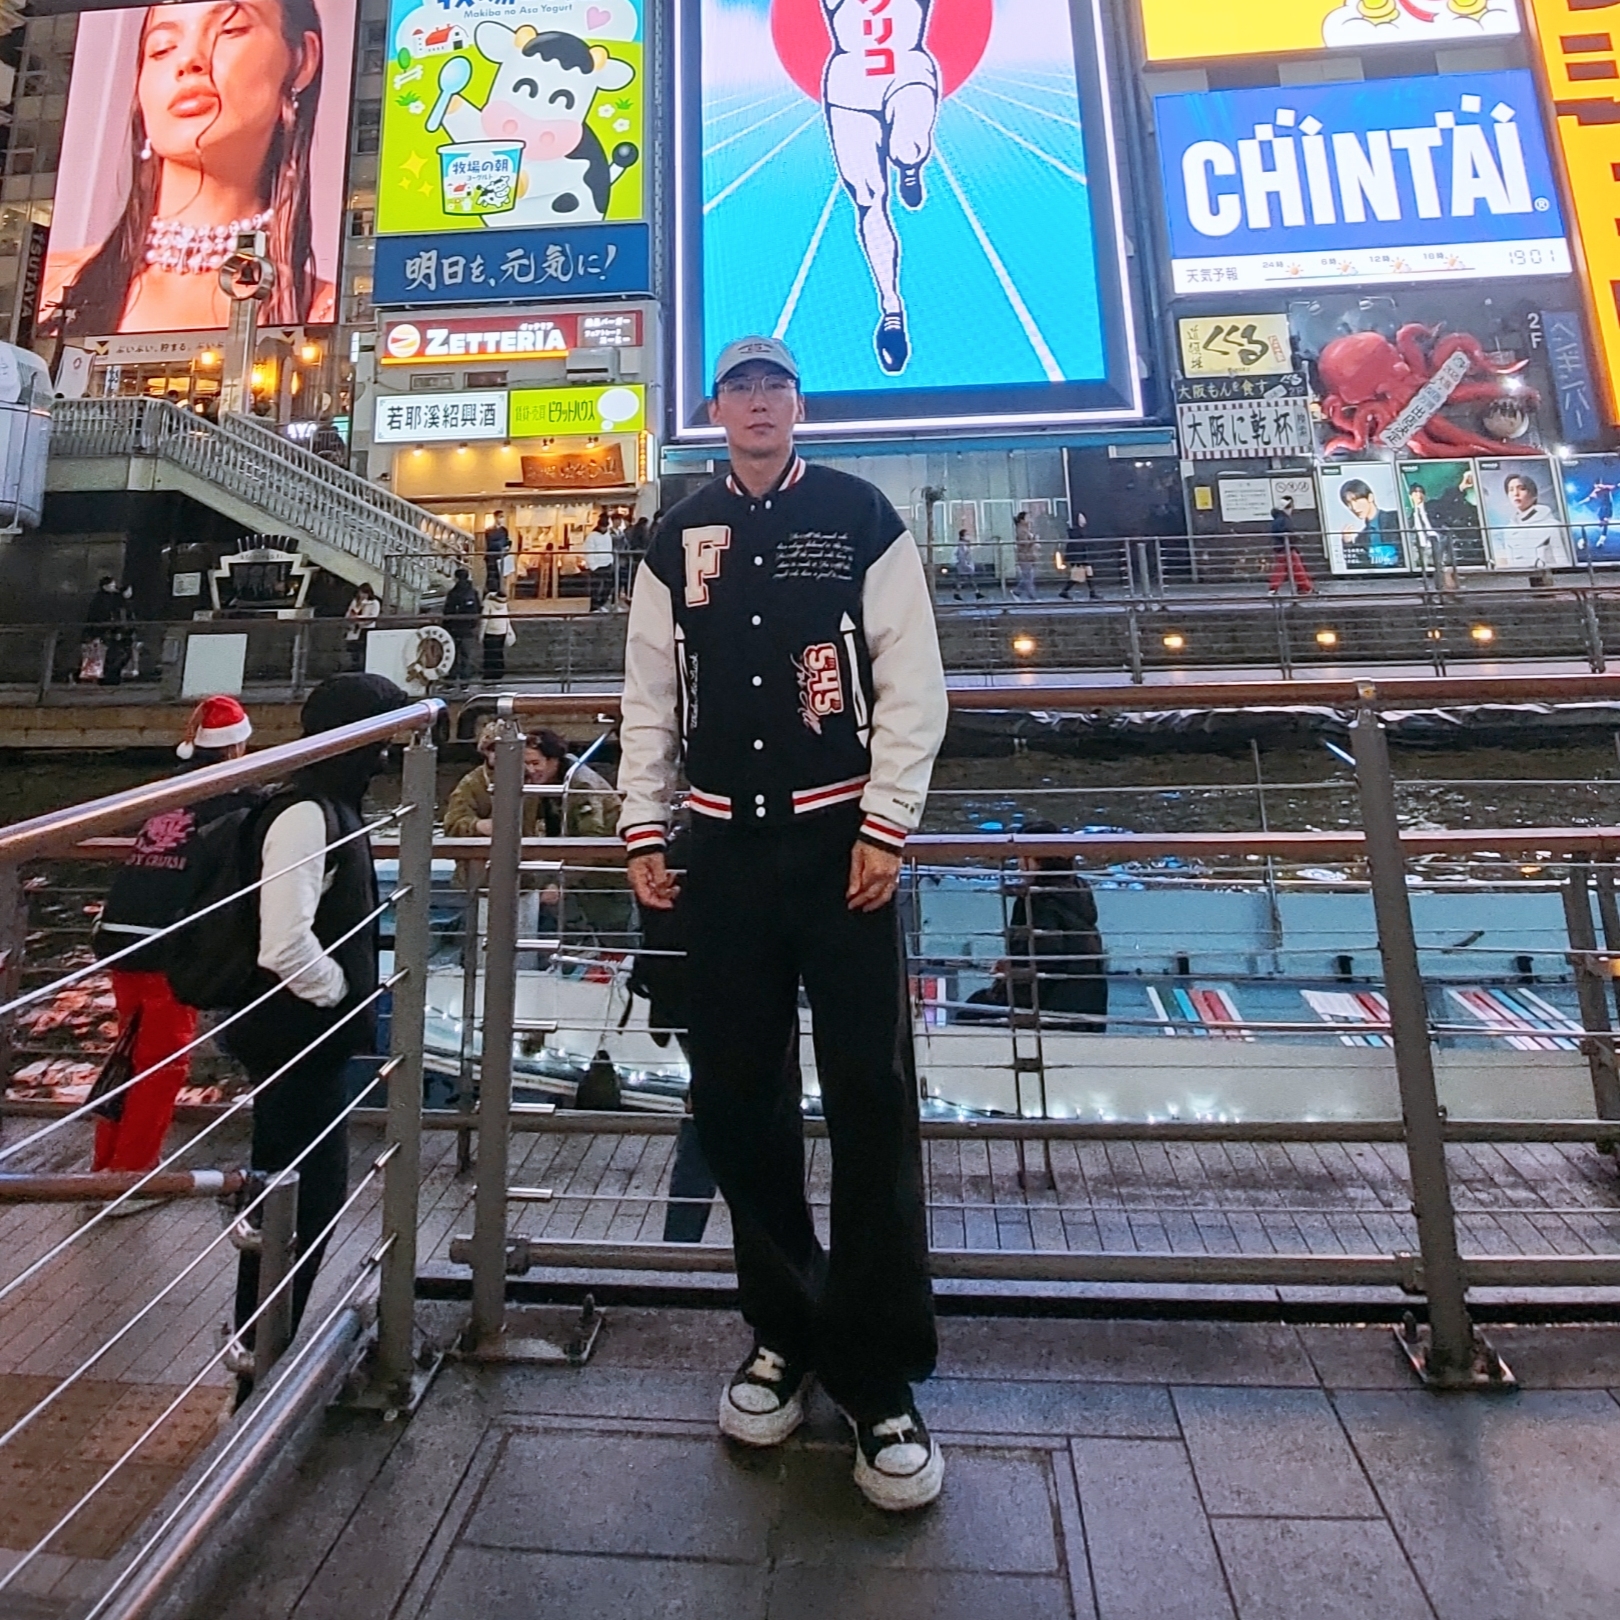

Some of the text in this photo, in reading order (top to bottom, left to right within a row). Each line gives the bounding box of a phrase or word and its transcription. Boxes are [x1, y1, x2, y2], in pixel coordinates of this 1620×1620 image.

[463, 9, 501, 18] Makiba
[519, 6, 538, 14] Asa
[540, 4, 573, 13] Yogurt
[452, 159, 509, 174] 牧場の朝
[1182, 94, 1533, 237] CHINTAI
[21, 228, 45, 318] TSUTAYA
[405, 243, 617, 291] 明日を、元気に!
[1185, 265, 1239, 283] 天気予報
[425, 328, 567, 356] ZETTERIA
[1202, 324, 1269, 366] くくる
[1527, 313, 1542, 349] 2F
[387, 402, 497, 430] 若耶溪紹興酒
[548, 400, 595, 423] ピタットハウス
[1187, 409, 1294, 449] 大阪に乾杯
[683, 525, 732, 607] F
[802, 643, 844, 716] 545
